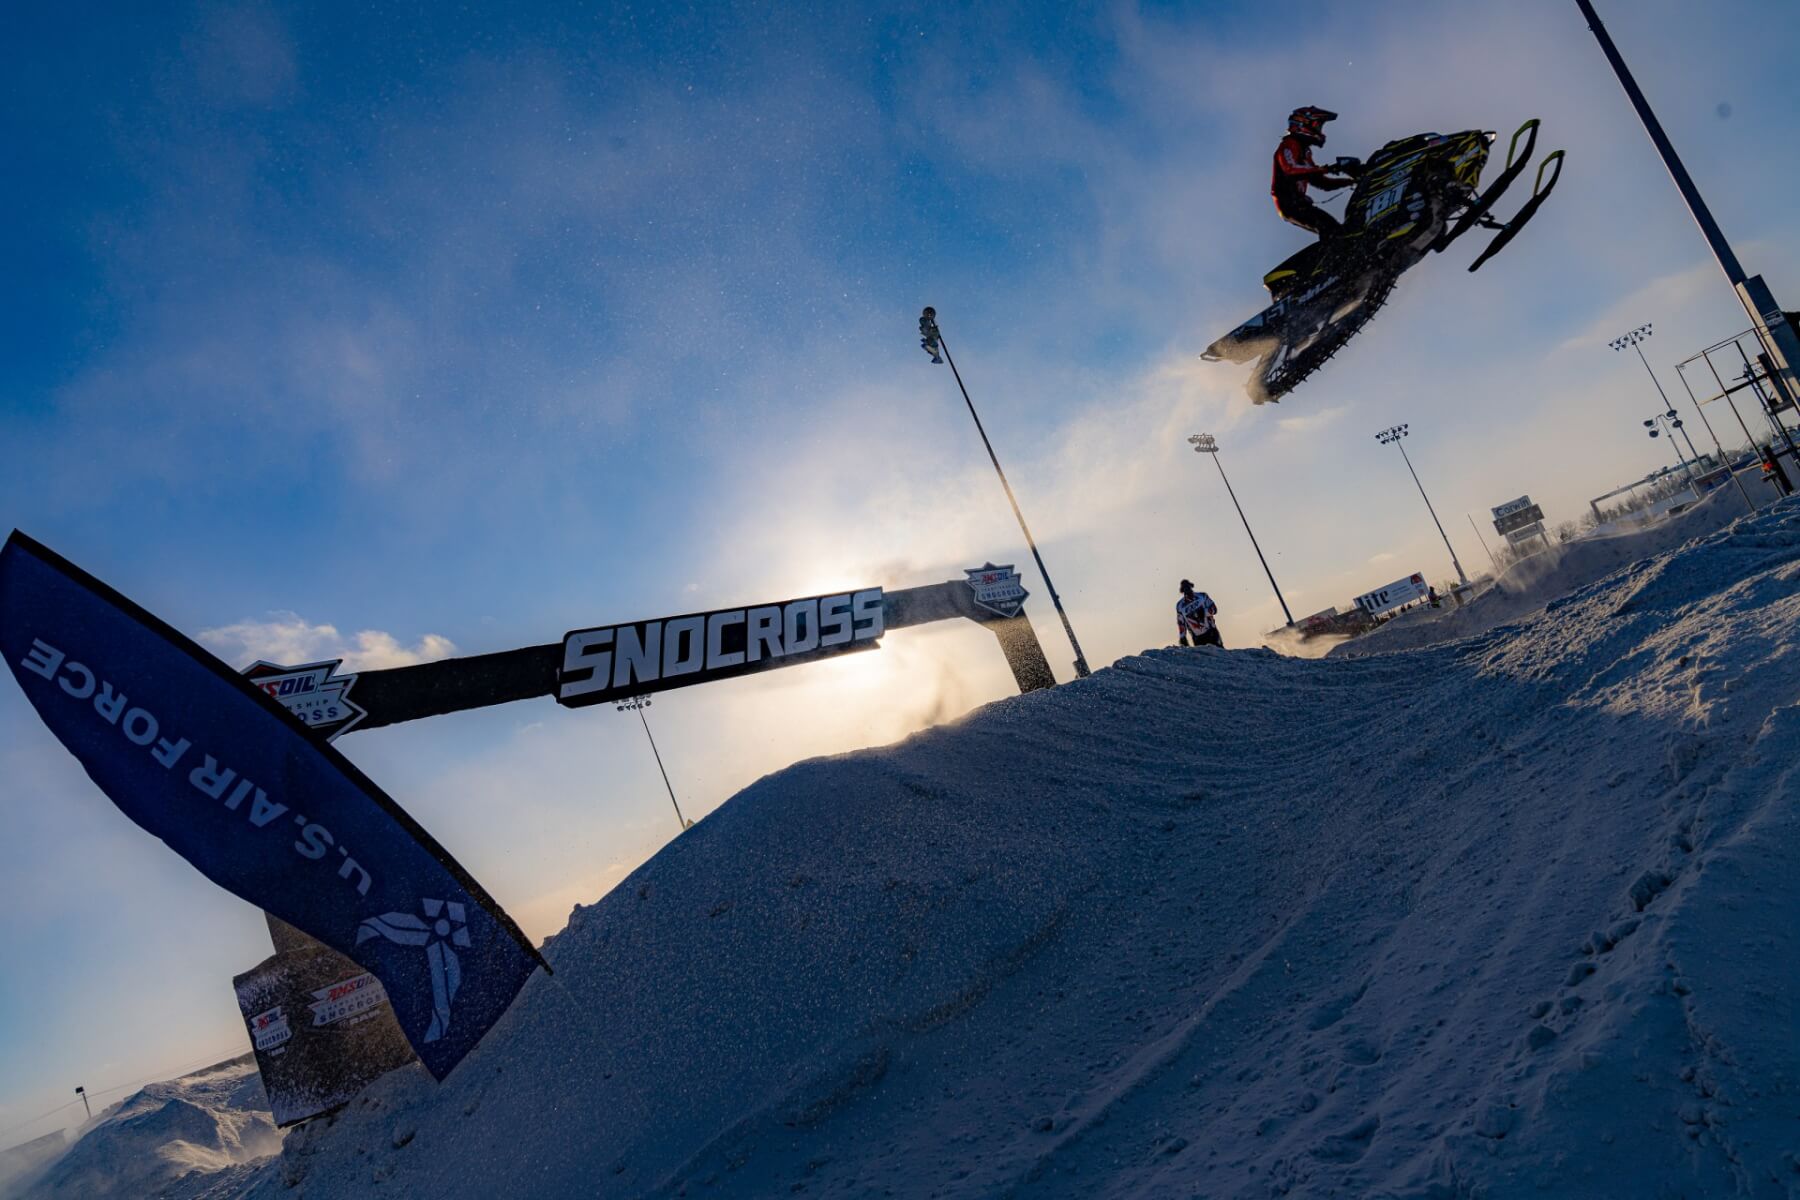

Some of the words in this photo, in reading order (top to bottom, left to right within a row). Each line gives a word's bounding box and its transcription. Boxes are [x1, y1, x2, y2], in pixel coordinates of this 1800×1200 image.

[1496, 499, 1529, 517] Corwin
[559, 588, 884, 698] SNOCROSS
[20, 637, 192, 769] FORCE
[258, 674, 316, 698] SOIL
[189, 754, 289, 827] AIR
[294, 814, 373, 896] U.S.
